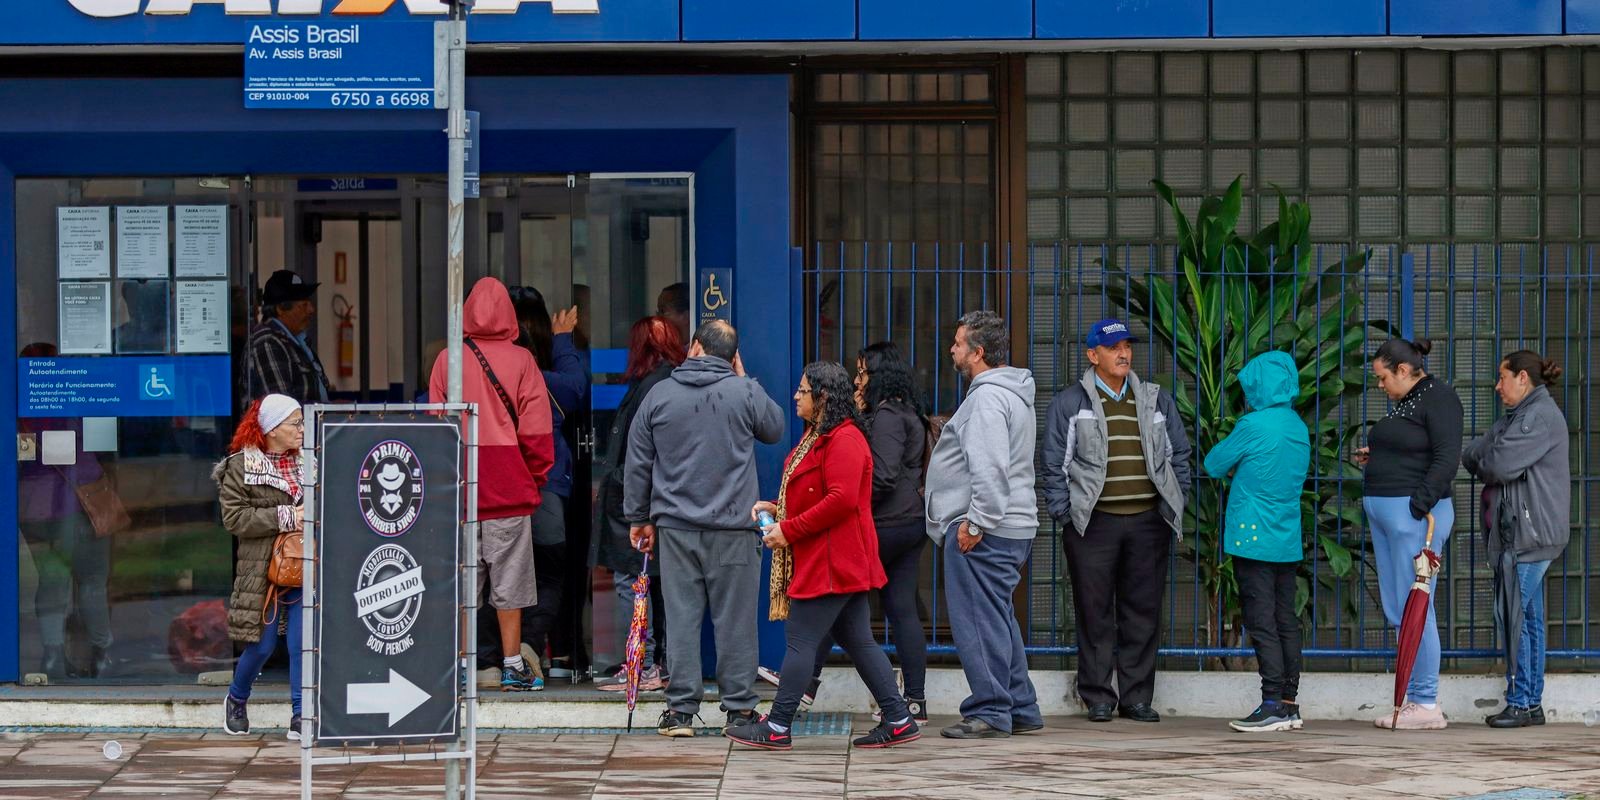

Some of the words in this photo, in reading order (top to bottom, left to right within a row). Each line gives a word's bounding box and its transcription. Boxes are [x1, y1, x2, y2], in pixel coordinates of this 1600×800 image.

[249, 24, 300, 44] Assis
[306, 24, 360, 44] Brasil
[249, 48, 268, 59] Av.
[272, 48, 304, 59] Assis
[308, 48, 342, 59] Brasil
[331, 92, 370, 106] 6750
[375, 96, 385, 106] a
[390, 92, 429, 106] 6698
[372, 443, 412, 464] PRIMUS
[412, 484, 421, 493] RS
[366, 508, 396, 534] BARBER
[397, 506, 416, 529] SHOP
[360, 588, 392, 608] OUTRO
[394, 576, 418, 594] LADO
[377, 614, 412, 634] CORPORAL
[366, 634, 384, 653] BODY
[385, 634, 415, 656] PIERCING
